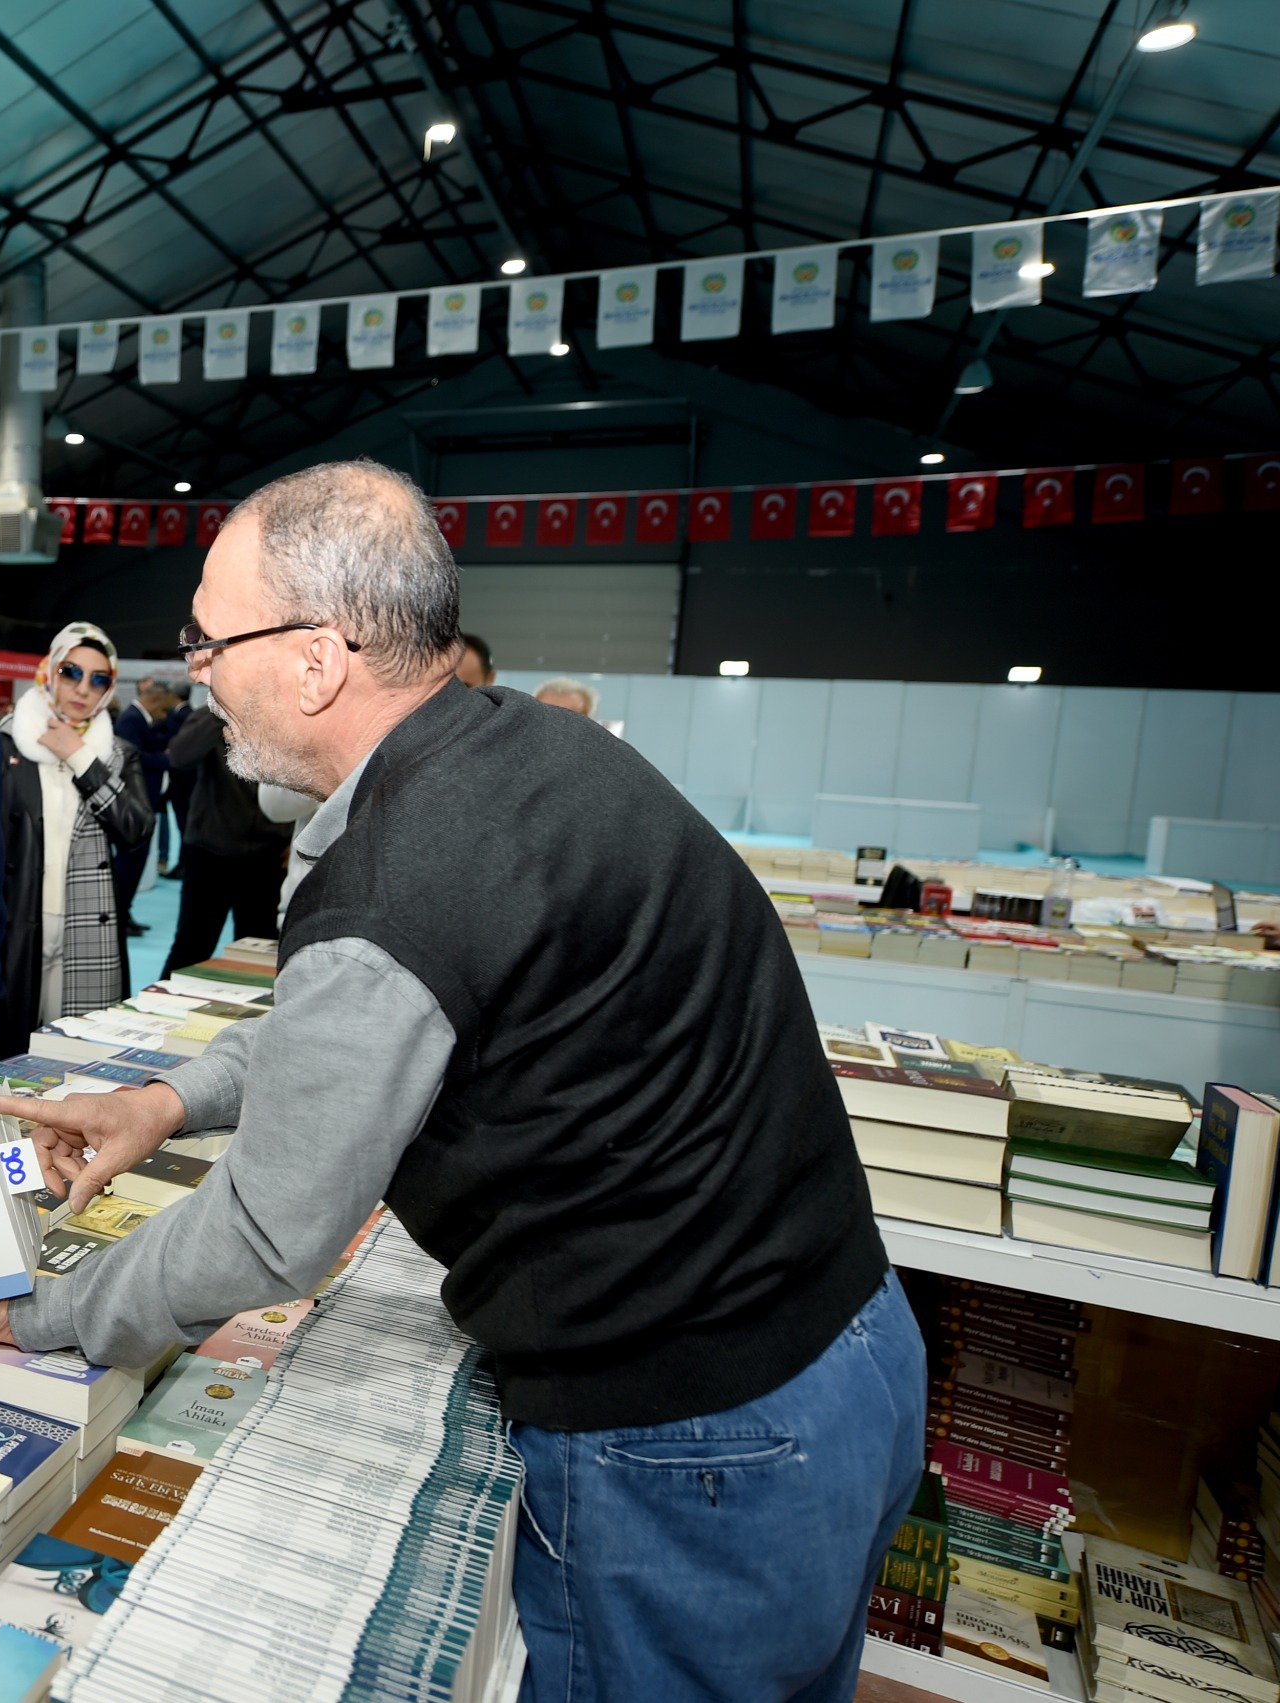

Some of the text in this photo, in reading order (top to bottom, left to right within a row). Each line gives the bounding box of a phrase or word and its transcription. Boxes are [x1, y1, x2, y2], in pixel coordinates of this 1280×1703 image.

[214, 1367, 249, 1381] AHLAK
[190, 1399, 225, 1418] İman
[1096, 1564, 1166, 1600] TARİHİ
[867, 1593, 901, 1617] EVÎ
[1097, 1581, 1169, 1616] KUR'ÂN
